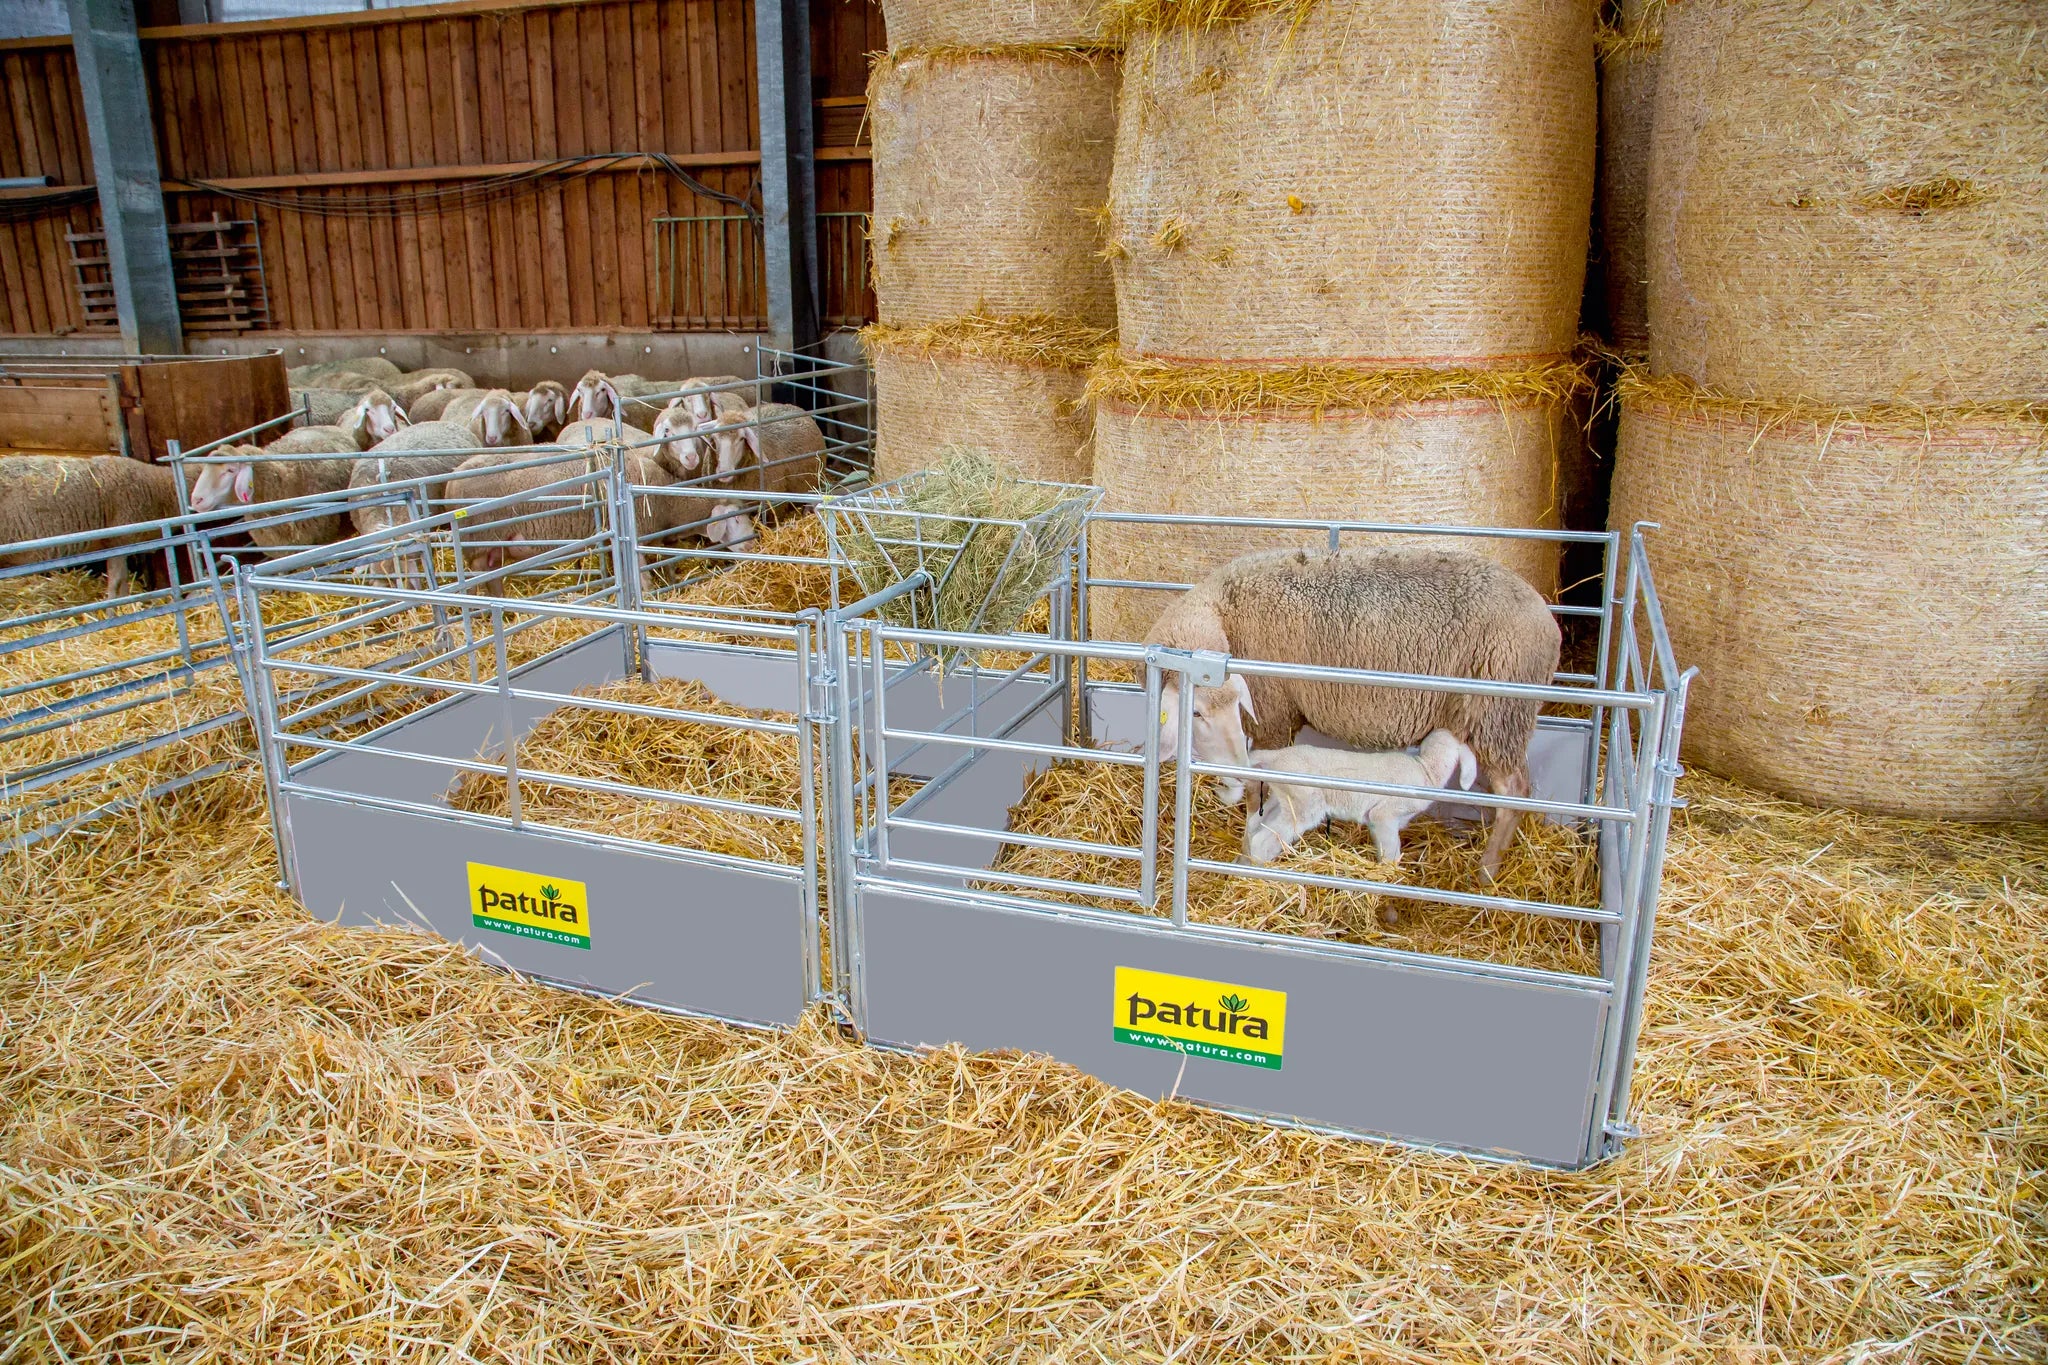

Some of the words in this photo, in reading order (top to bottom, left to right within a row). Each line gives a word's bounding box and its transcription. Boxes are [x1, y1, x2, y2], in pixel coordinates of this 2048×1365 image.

[478, 883, 578, 924] patura
[483, 919, 580, 944] www.patura.com
[1126, 991, 1268, 1040] patura
[1129, 1032, 1267, 1064] www.patura.com
